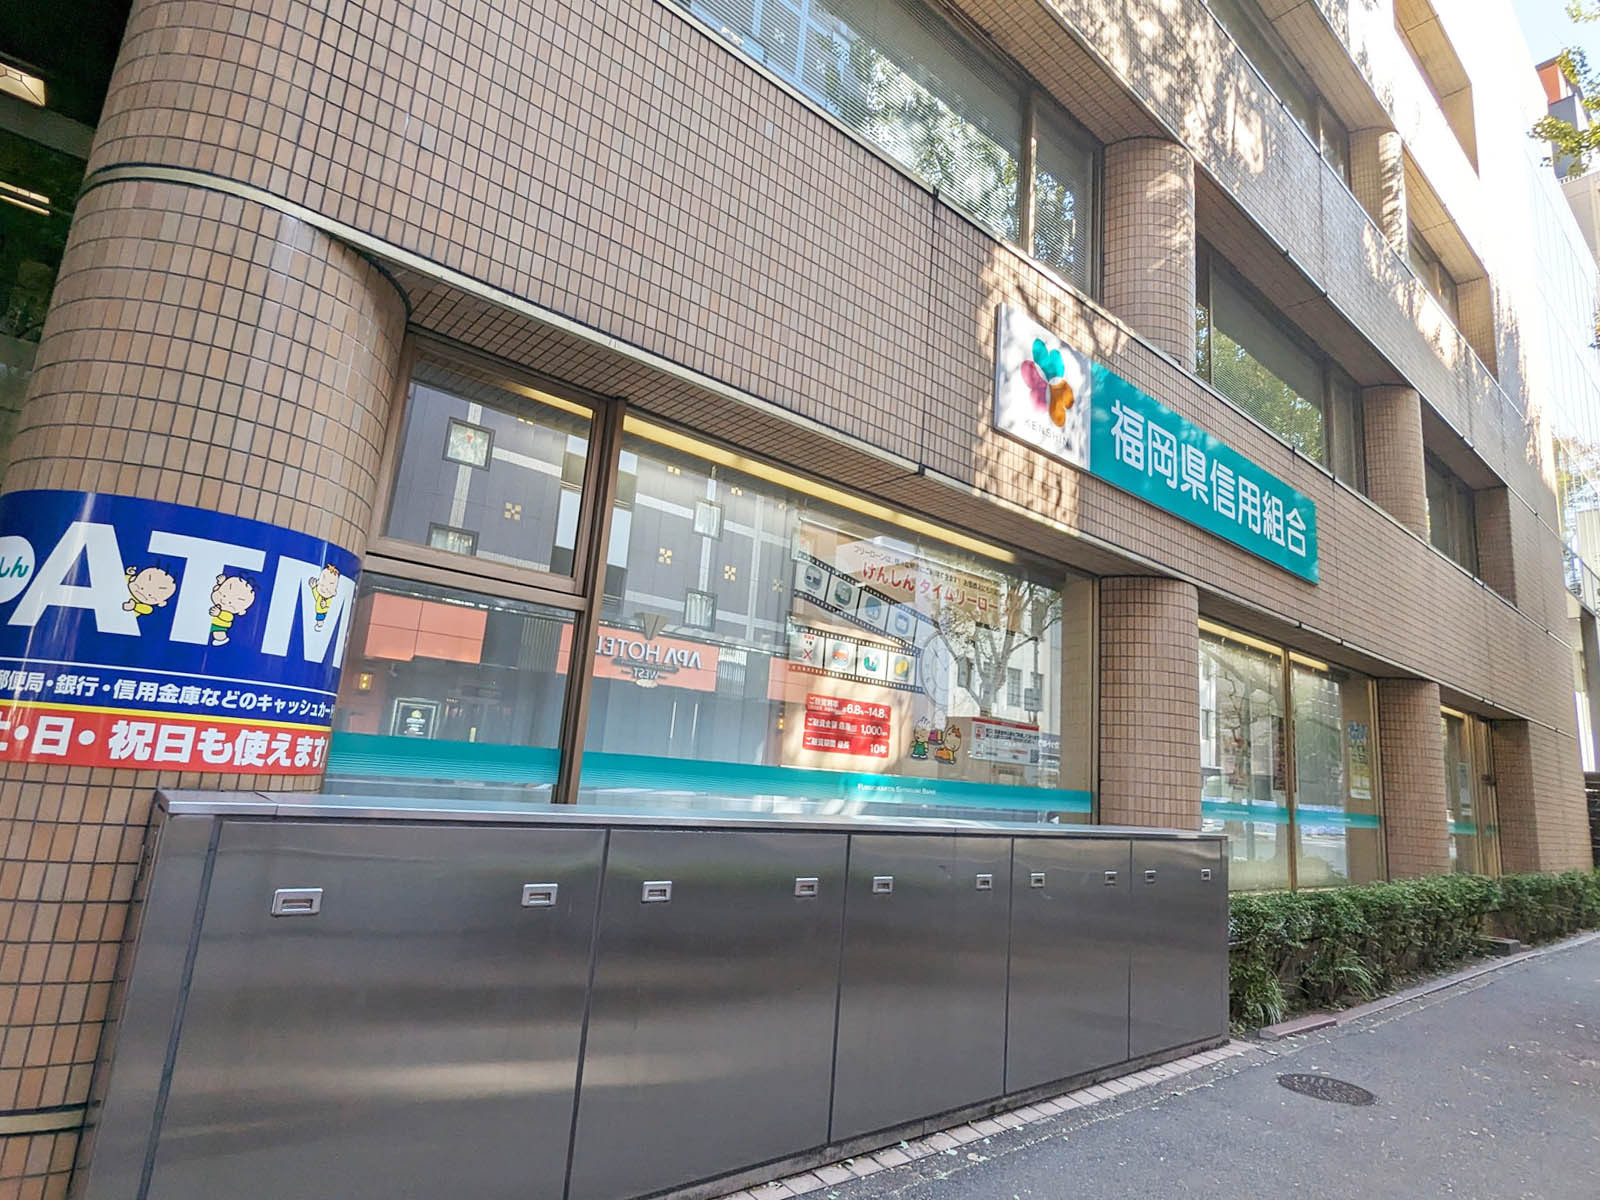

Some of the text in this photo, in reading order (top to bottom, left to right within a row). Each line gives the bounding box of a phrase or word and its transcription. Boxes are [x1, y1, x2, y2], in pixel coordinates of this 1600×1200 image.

[1110, 399, 1307, 557] 福岡県信用組合
[7, 520, 358, 669] ATM
